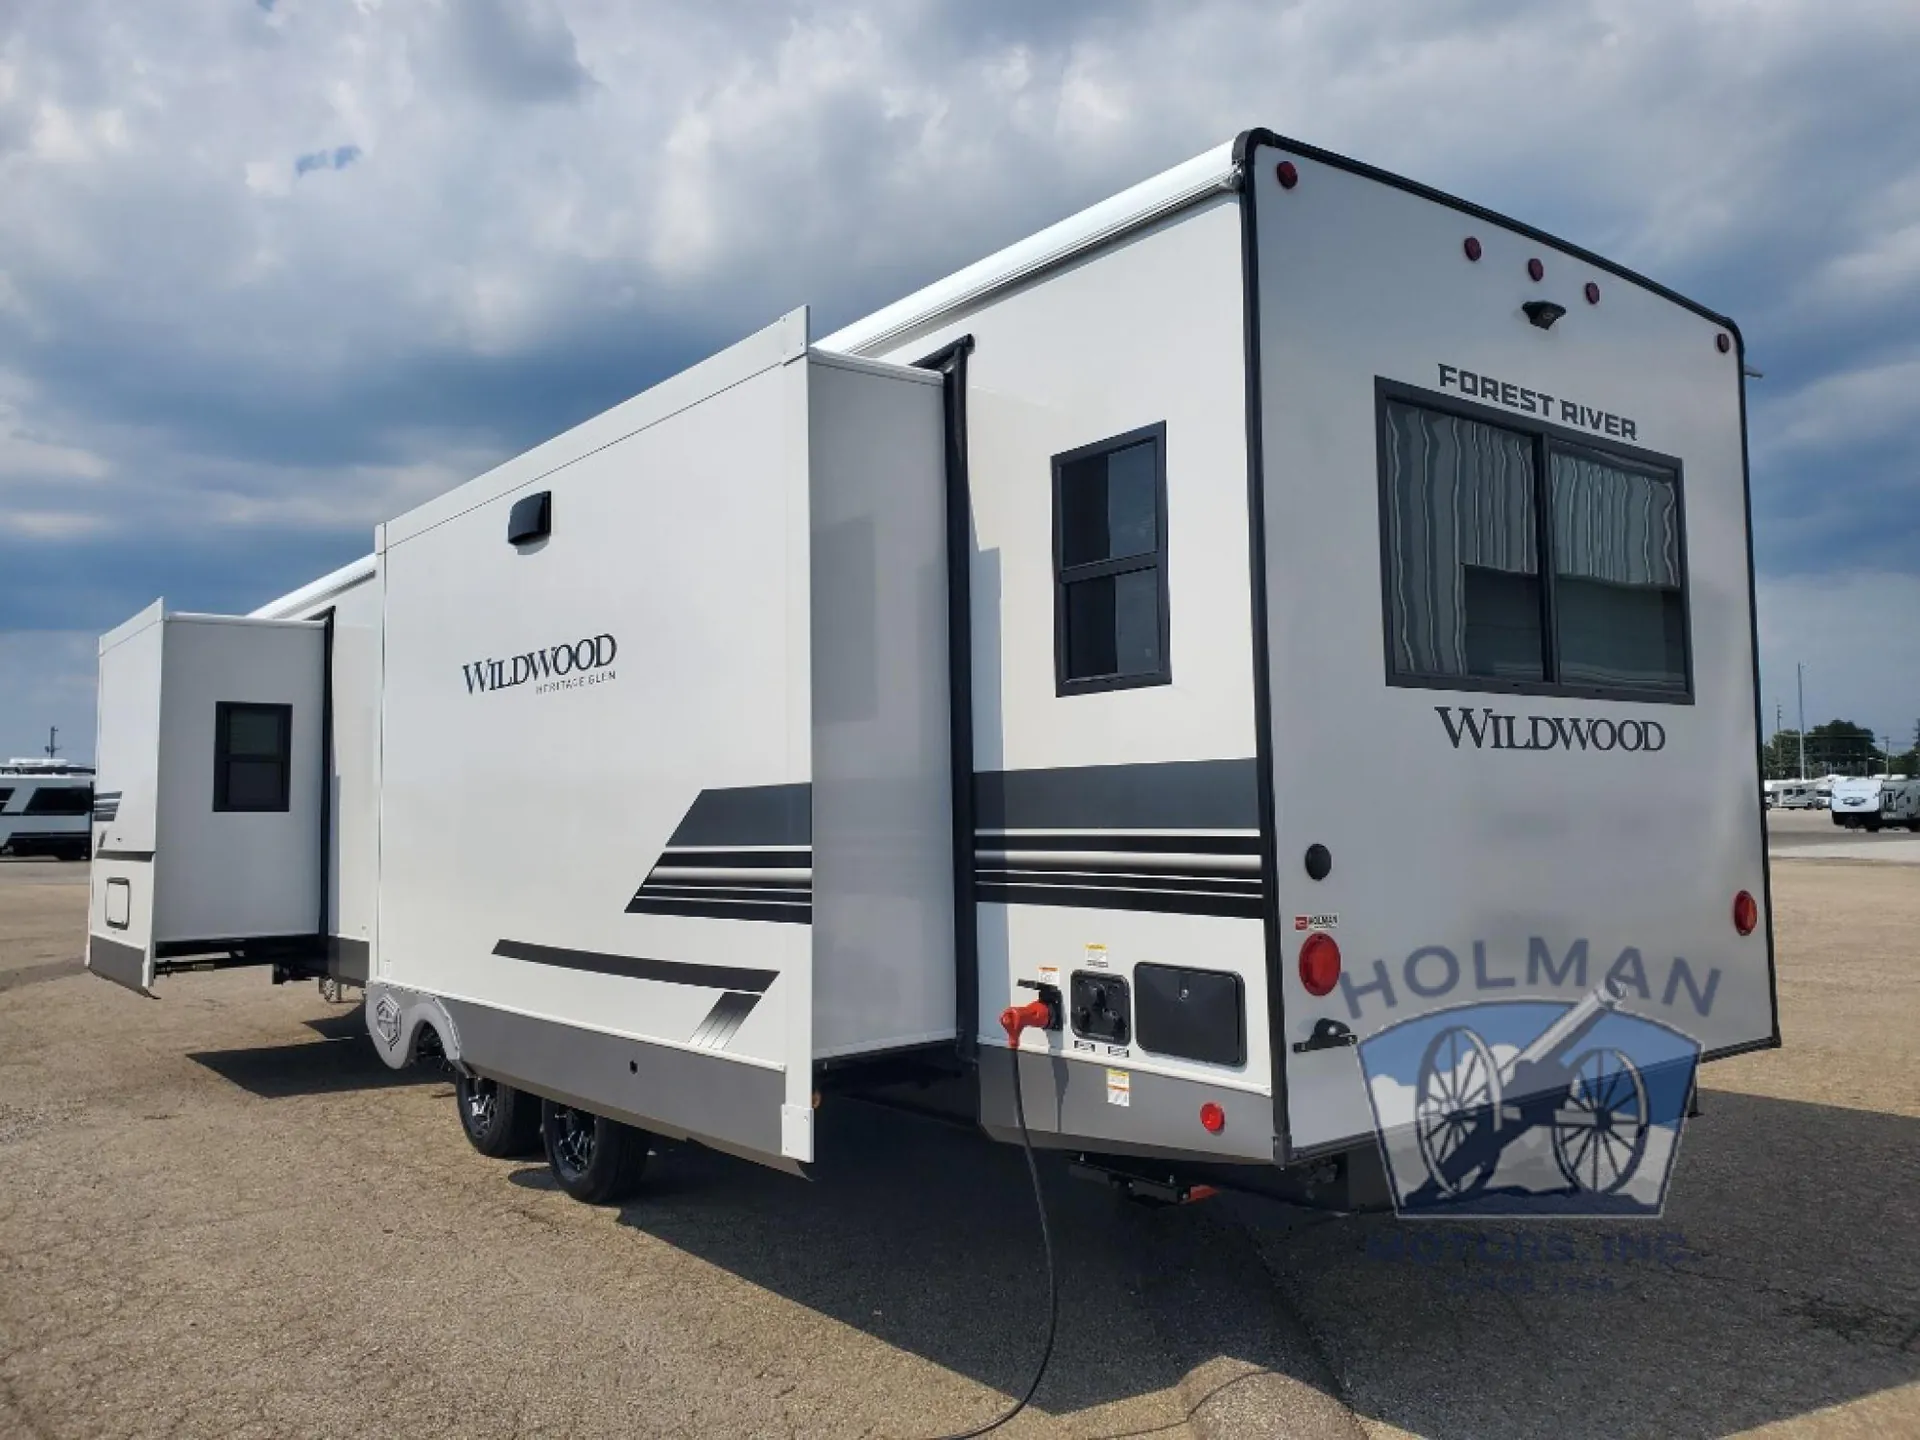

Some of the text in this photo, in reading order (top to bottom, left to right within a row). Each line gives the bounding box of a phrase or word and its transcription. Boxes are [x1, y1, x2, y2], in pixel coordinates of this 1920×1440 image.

[1437, 363, 1637, 441] FOREST RIVER
[462, 633, 618, 695] WILDWOOD
[535, 670, 617, 695] HERITAGE GLEN
[1434, 706, 1666, 752] WILDWOOD
